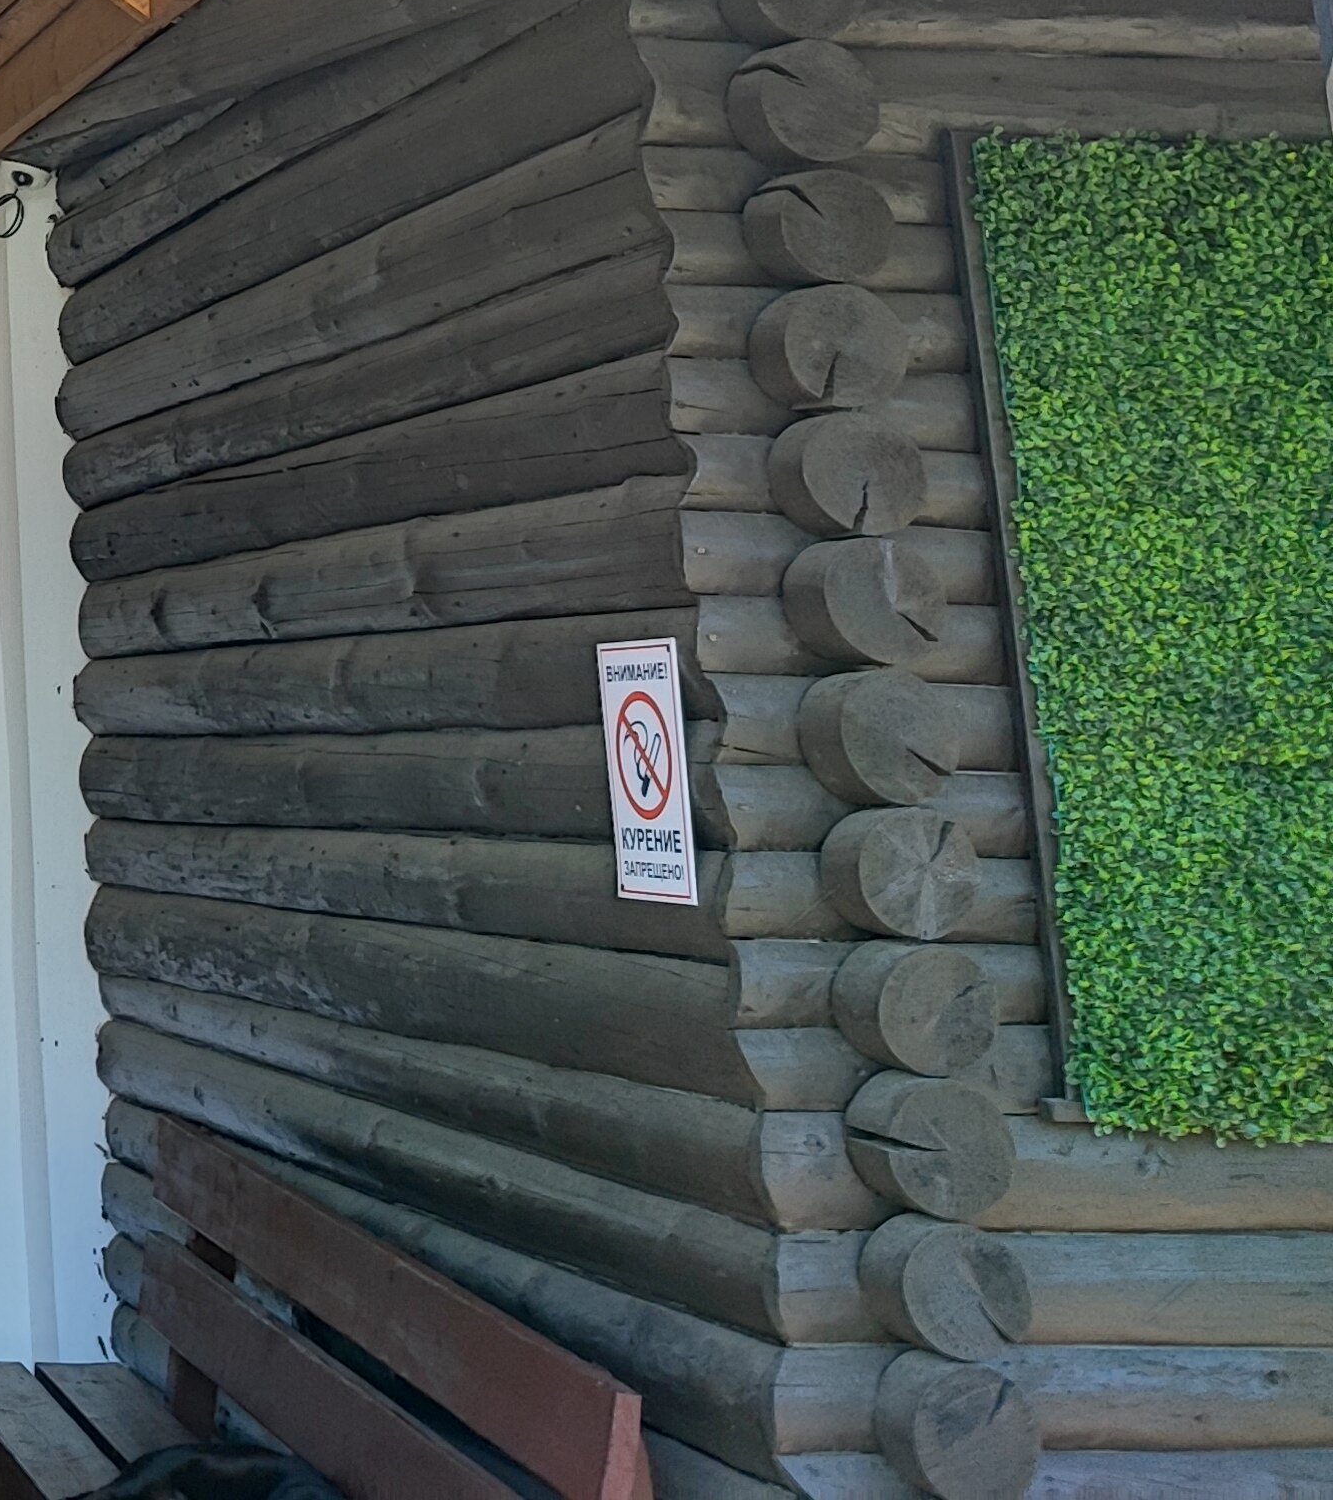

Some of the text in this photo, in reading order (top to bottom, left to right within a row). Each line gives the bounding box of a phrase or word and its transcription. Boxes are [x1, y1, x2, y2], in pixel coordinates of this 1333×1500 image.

[606, 662, 668, 682] ВНИМАНИЕ!
[621, 827, 683, 854] КУРЕНИЕ
[624, 860, 685, 882] ЗАПРЕЩЕНО!
